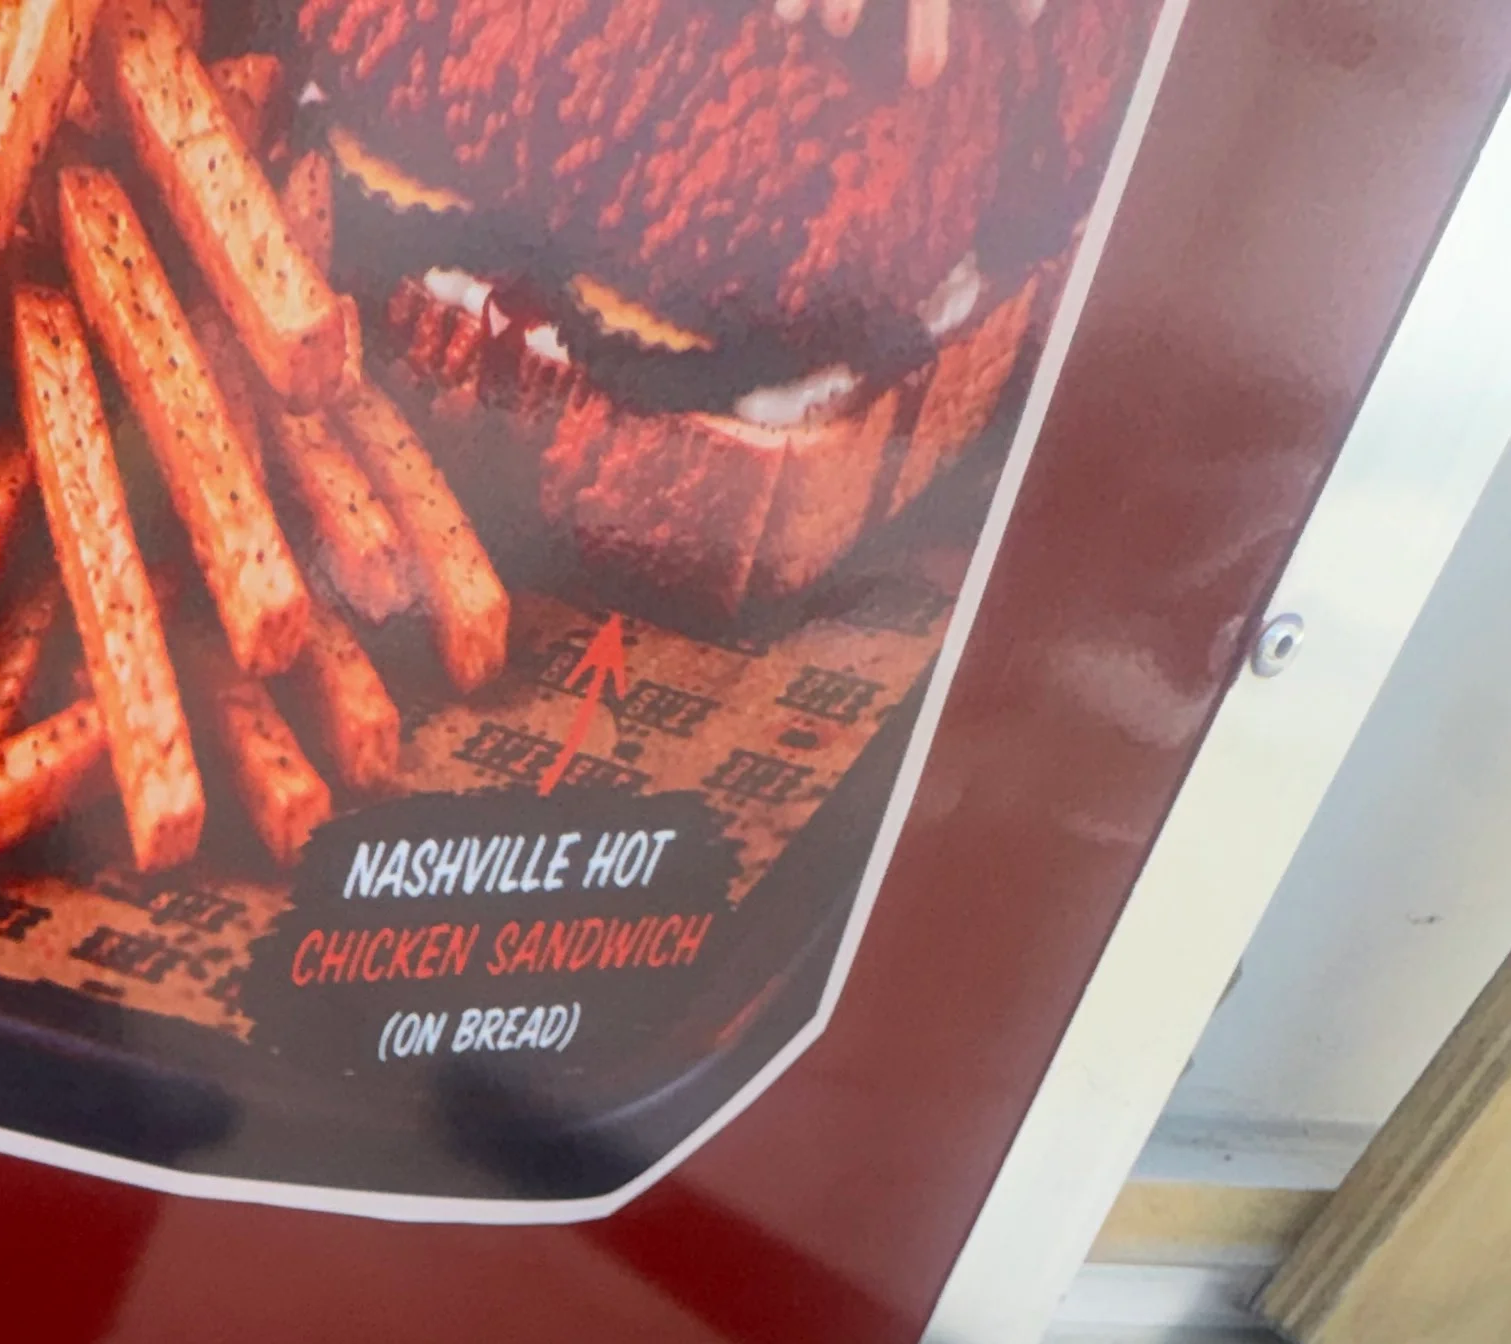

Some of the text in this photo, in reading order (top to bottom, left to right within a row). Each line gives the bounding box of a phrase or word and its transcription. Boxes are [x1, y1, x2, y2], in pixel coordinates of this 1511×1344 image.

[343, 829, 677, 900] NASHVILLE HOT
[291, 912, 713, 986] CHICKEN SANDWICH
[378, 1001, 582, 1062] (ON BREAD)
